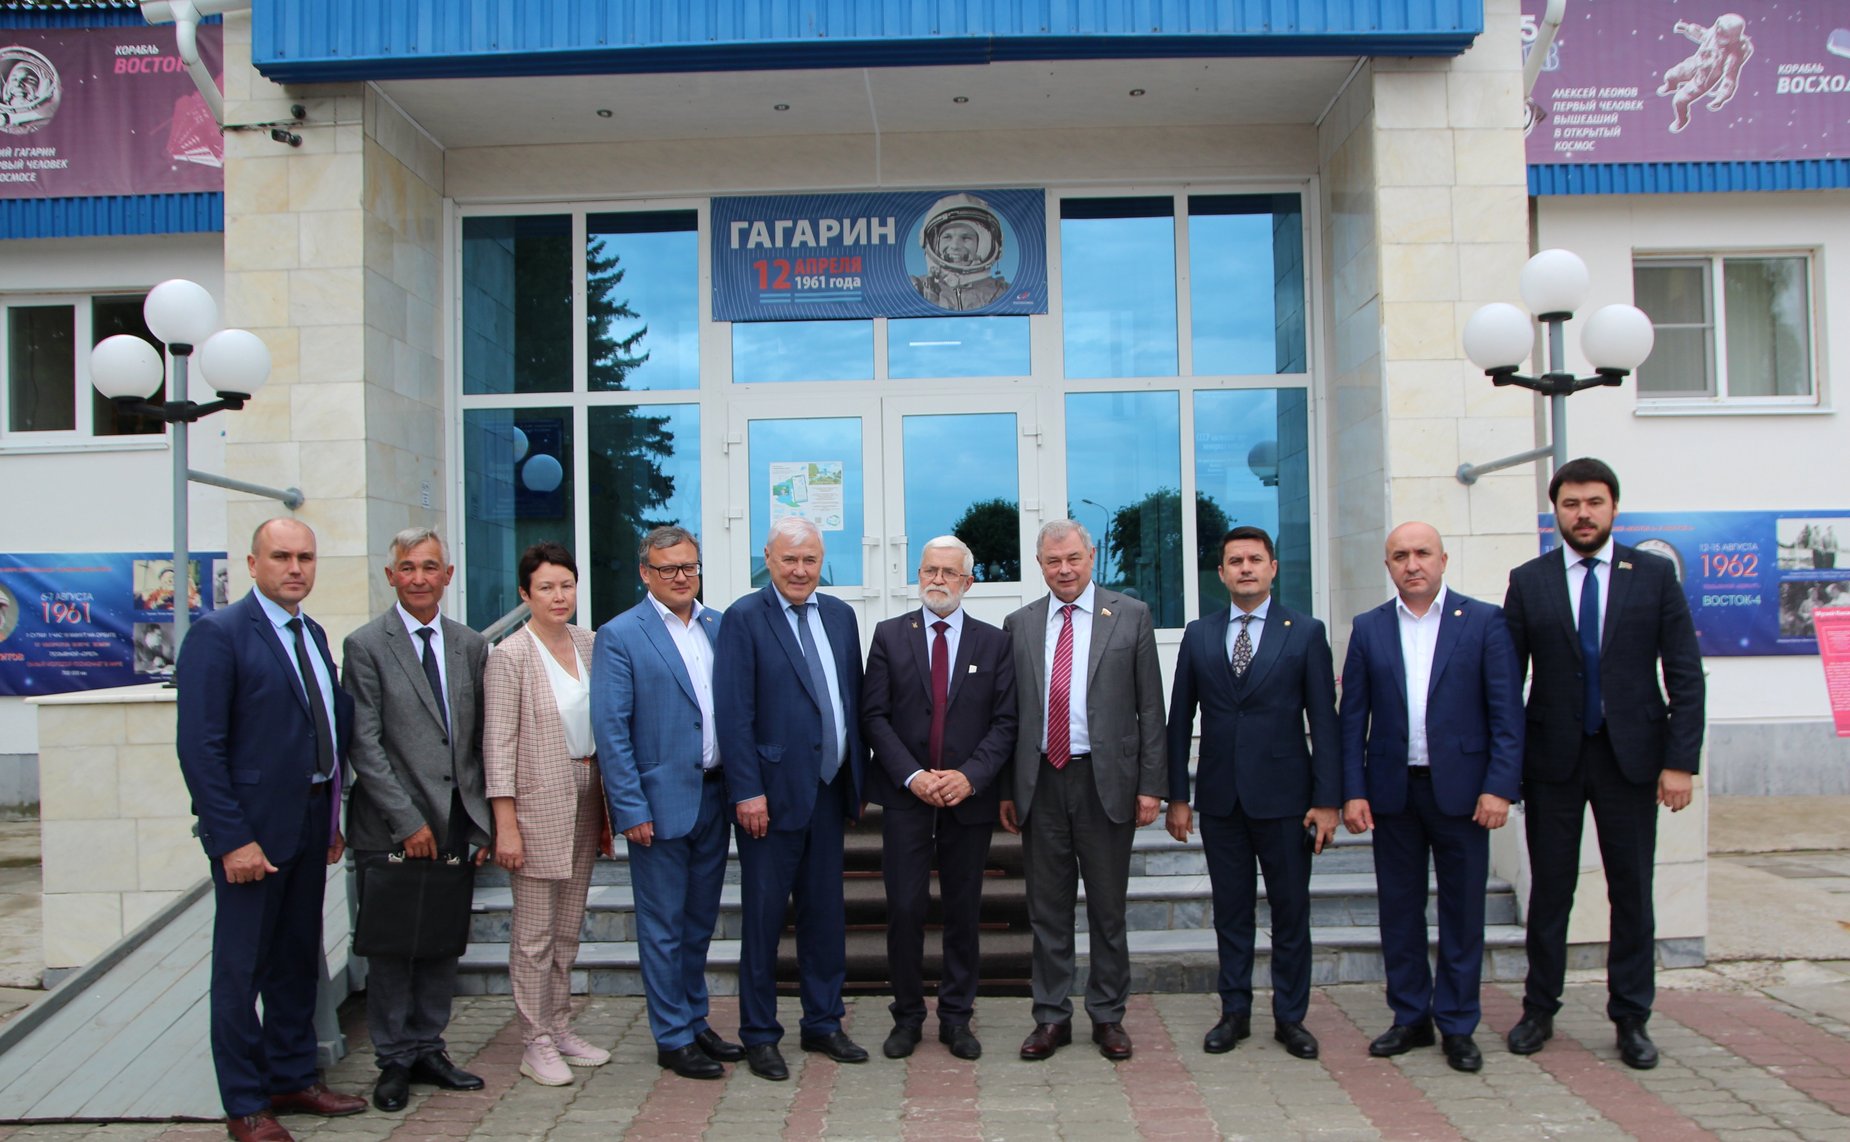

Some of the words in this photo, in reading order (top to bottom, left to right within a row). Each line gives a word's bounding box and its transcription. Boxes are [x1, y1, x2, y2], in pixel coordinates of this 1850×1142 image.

[115, 44, 160, 56] КОРАБЛЬ
[1777, 62, 1825, 75] КОРАБЛЬ
[1552, 86, 1597, 99] АЛЕКСЕЙ
[1598, 87, 1639, 99] ЛЕОНОВ
[1552, 99, 1597, 112] ПЕРВЫЙ
[1599, 99, 1644, 111] ЧЕЛОВЕК
[1553, 112, 1619, 126] ВЫШЕДШИЙ
[1553, 127, 1562, 138] В
[1563, 125, 1622, 139] ОТКРЫТЫЙ
[14, 147, 56, 157] ГАГАРИН
[1554, 140, 1596, 152] КОСМОС
[26, 159, 69, 170] ЧЕЛОВЕК
[730, 216, 896, 249] ГАГАРИН
[794, 256, 863, 275] АПРЕЛЯ
[753, 258, 792, 290] 12
[795, 276, 826, 289] 1961
[829, 276, 862, 290] года
[1700, 553, 1759, 577] 1962
[1702, 594, 1762, 606] ВОСТОК-4
[42, 601, 92, 624] 1961
